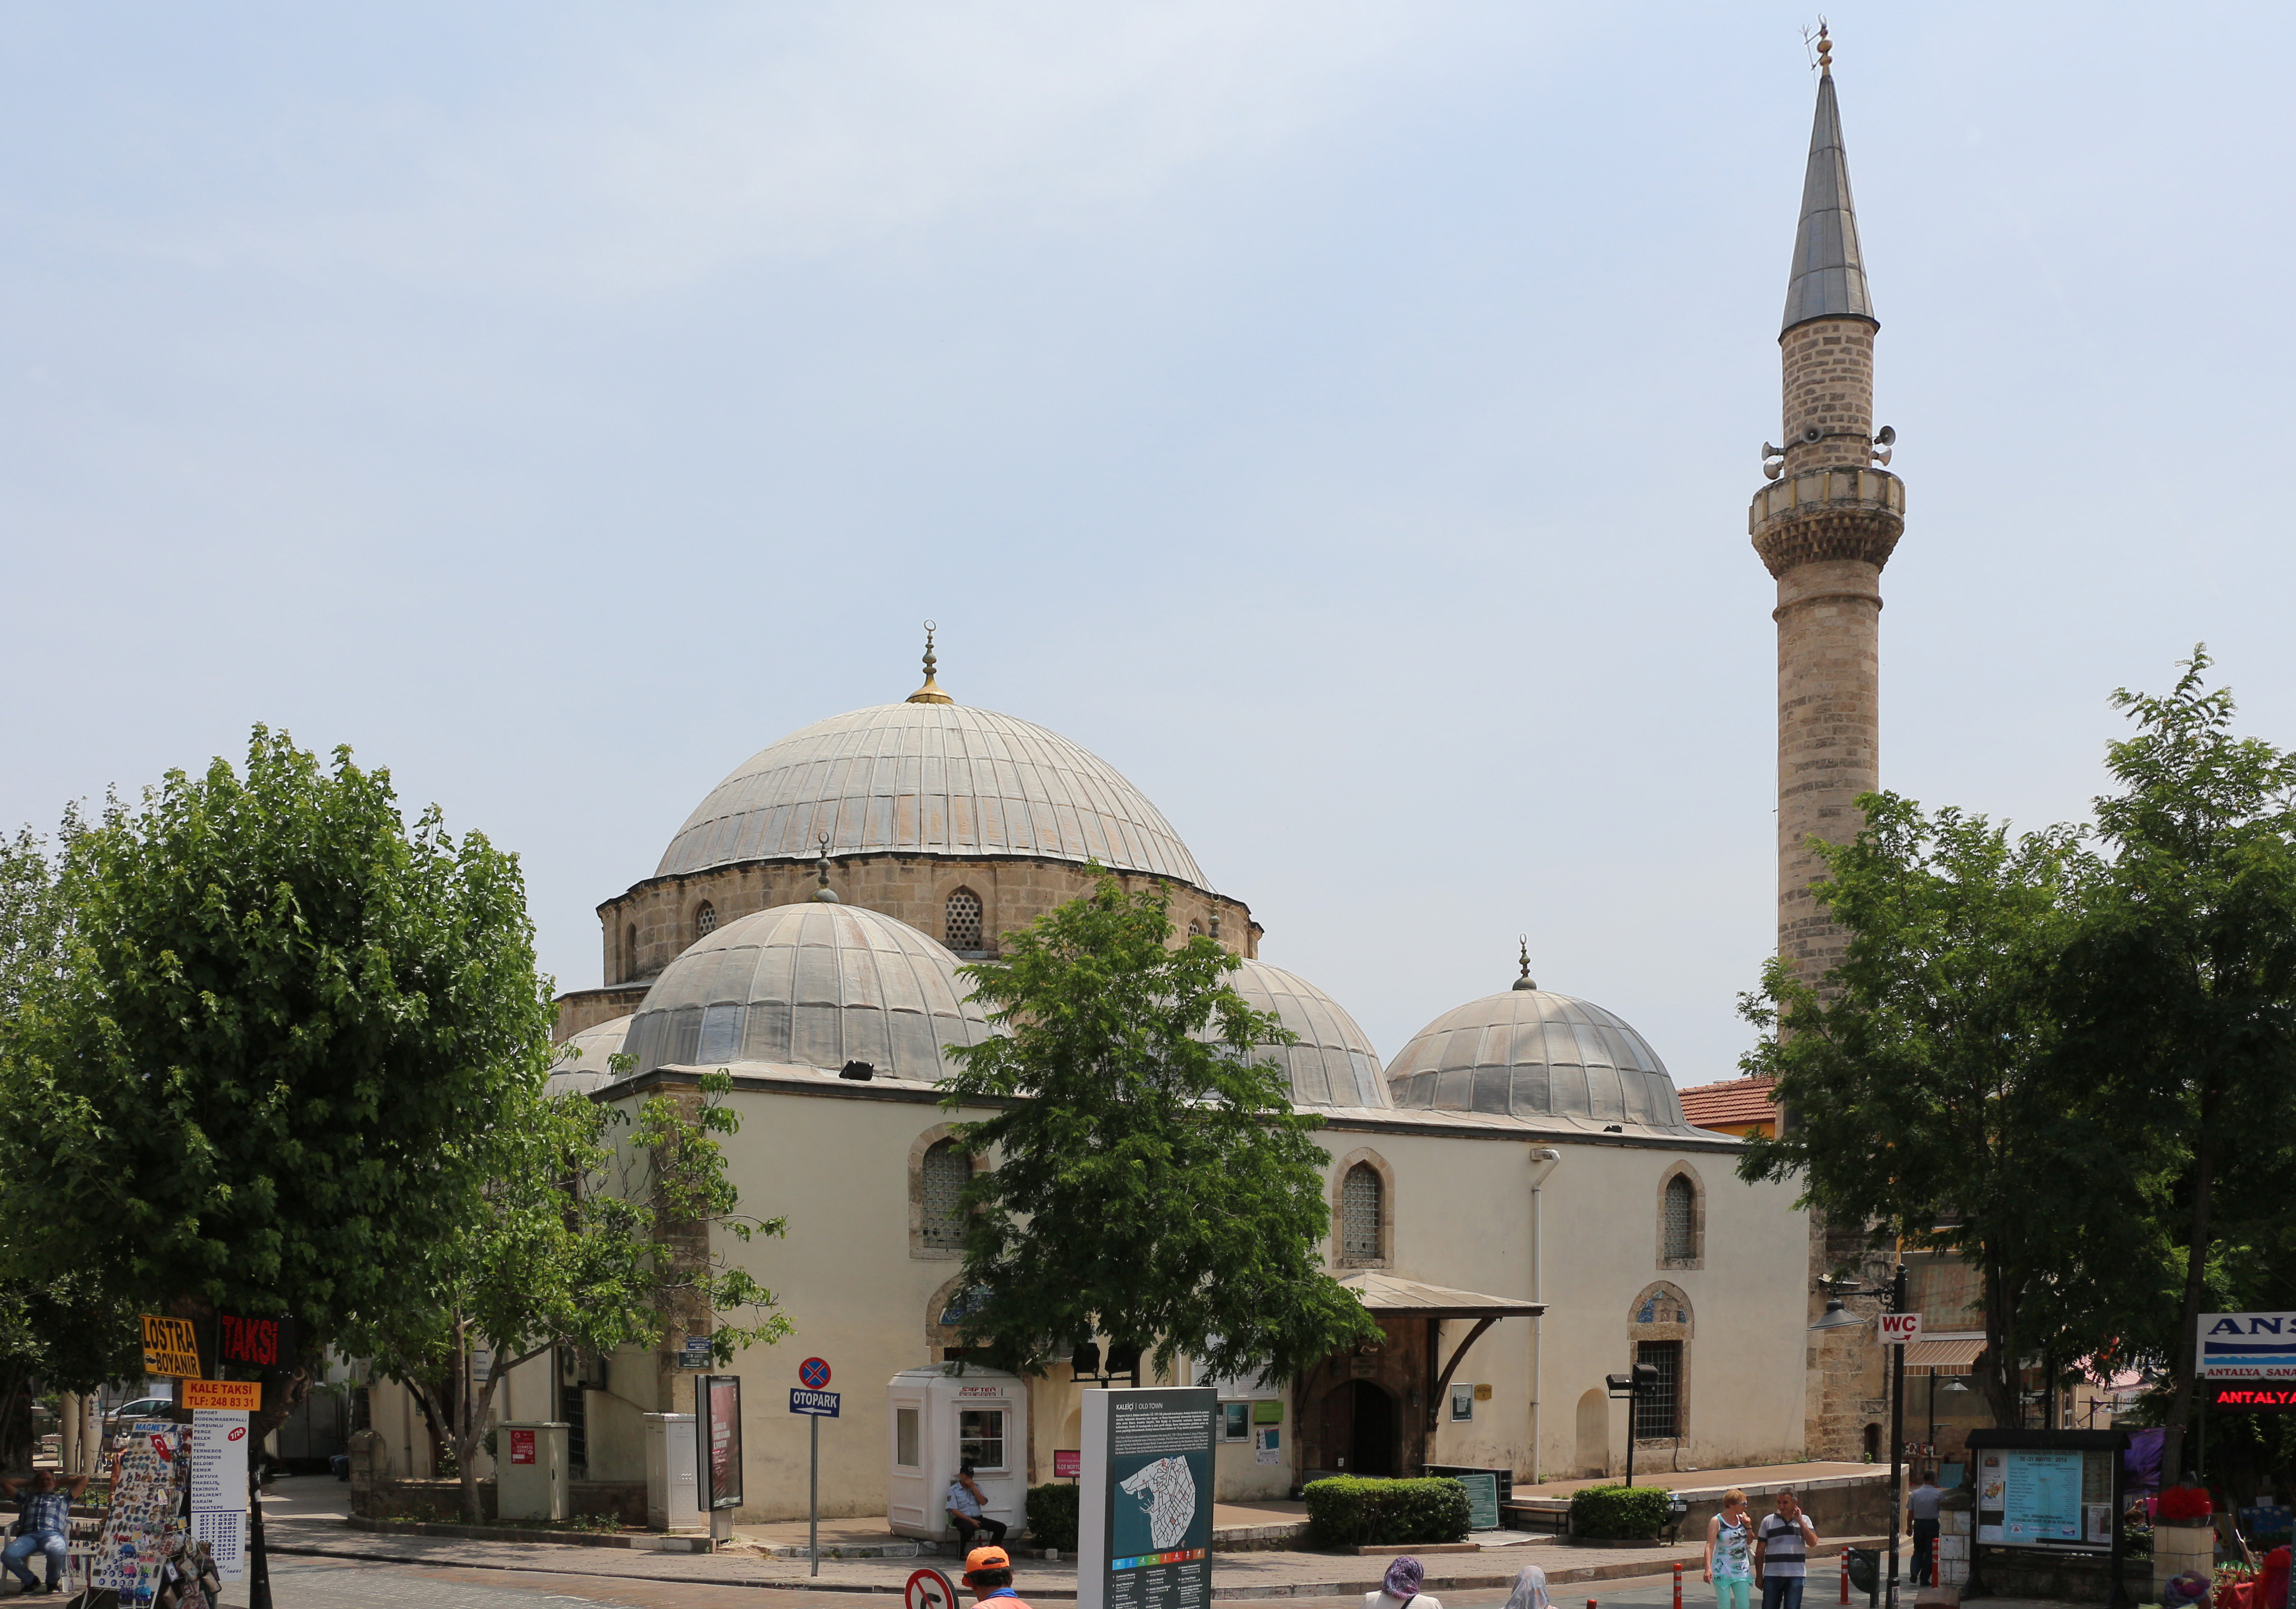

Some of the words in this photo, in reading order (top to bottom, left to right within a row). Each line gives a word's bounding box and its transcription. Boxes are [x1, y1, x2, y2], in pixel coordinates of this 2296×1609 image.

[1883, 1316, 1916, 1331] WC
[142, 1318, 196, 1353] LOSTRA
[155, 1352, 198, 1376] BOYANIR
[191, 1383, 218, 1393] KALE
[222, 1383, 252, 1394] TAKSİ
[188, 1396, 208, 1406] TLF:
[211, 1397, 227, 1406] 248
[231, 1397, 242, 1407] 83
[244, 1398, 253, 1407] 31
[793, 1392, 837, 1408] OTOPARK
[1116, 1402, 1134, 1411] KALEİÇİ
[230, 1429, 243, 1439] 7/24
